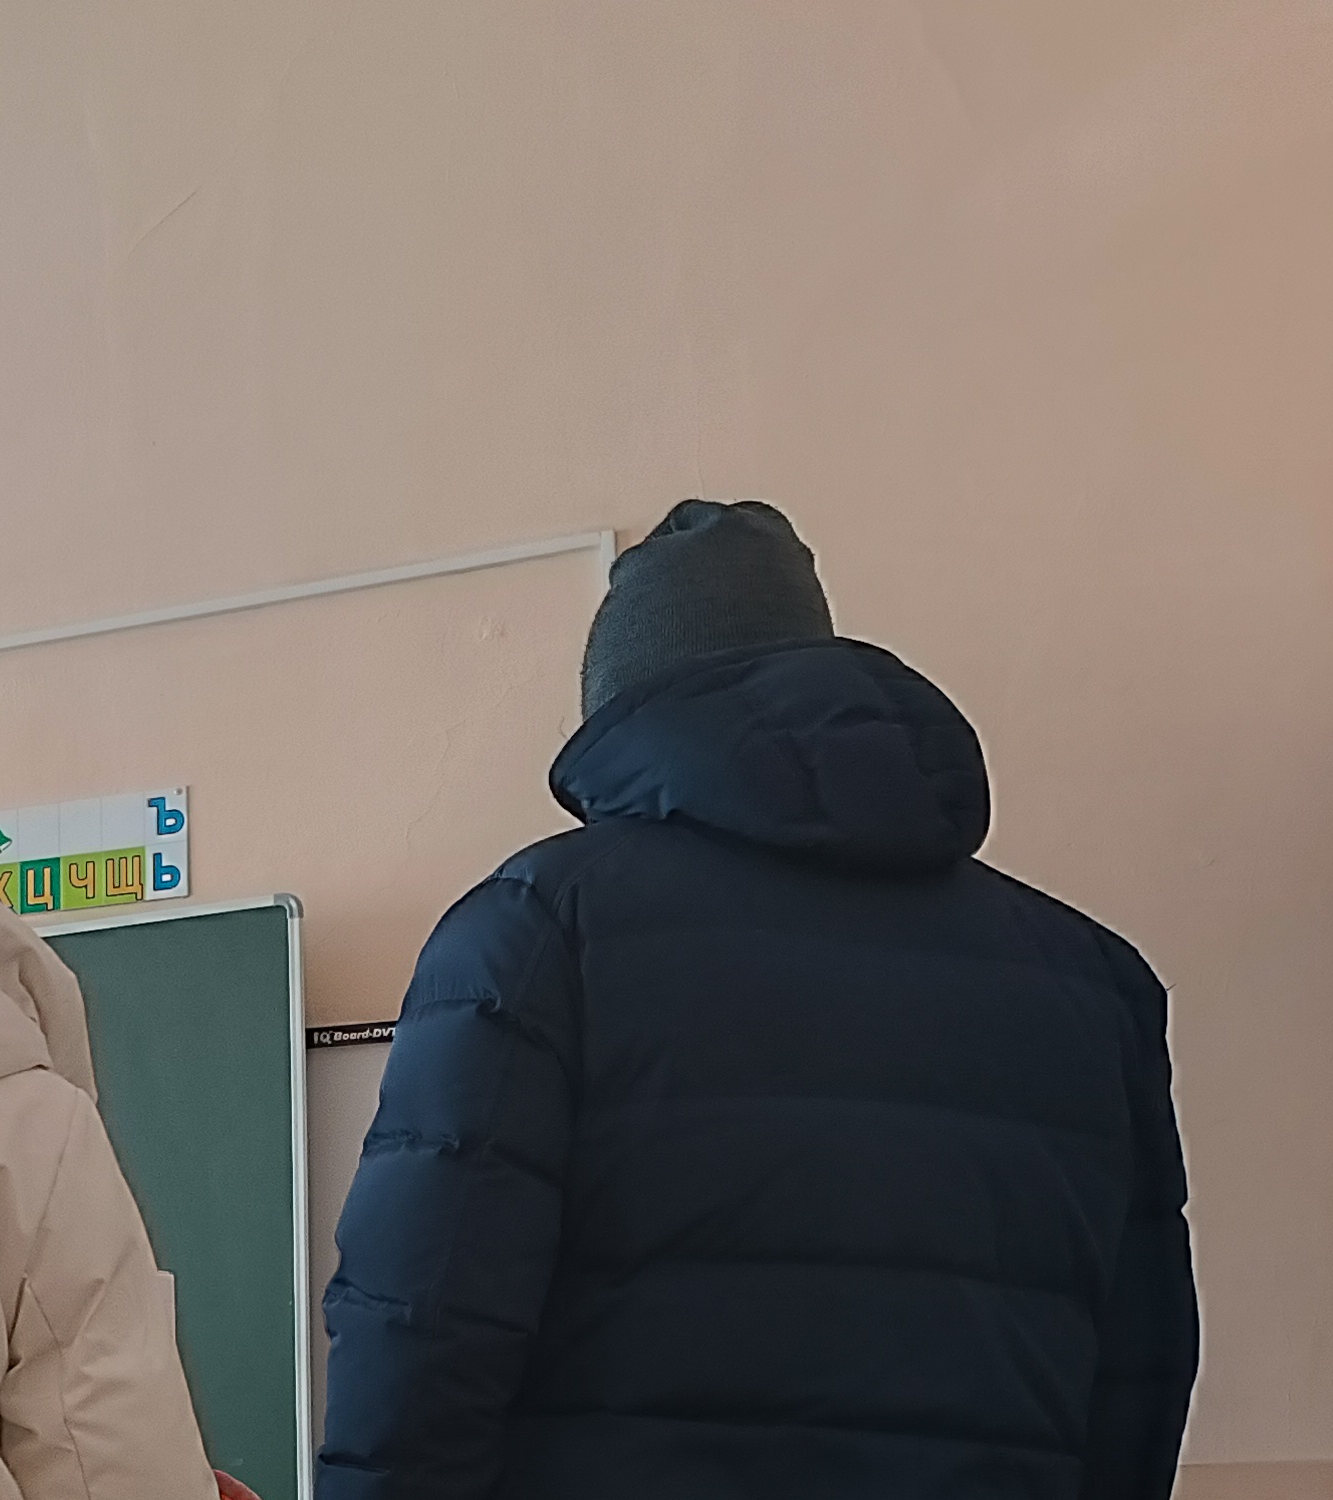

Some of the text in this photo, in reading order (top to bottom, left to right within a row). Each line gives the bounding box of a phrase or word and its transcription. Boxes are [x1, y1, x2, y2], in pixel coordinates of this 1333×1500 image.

[147, 797, 185, 835] Ъ
[27, 866, 54, 911] Ц
[69, 861, 95, 899] Ч
[105, 855, 143, 901] Щ
[153, 852, 181, 892] Ь
